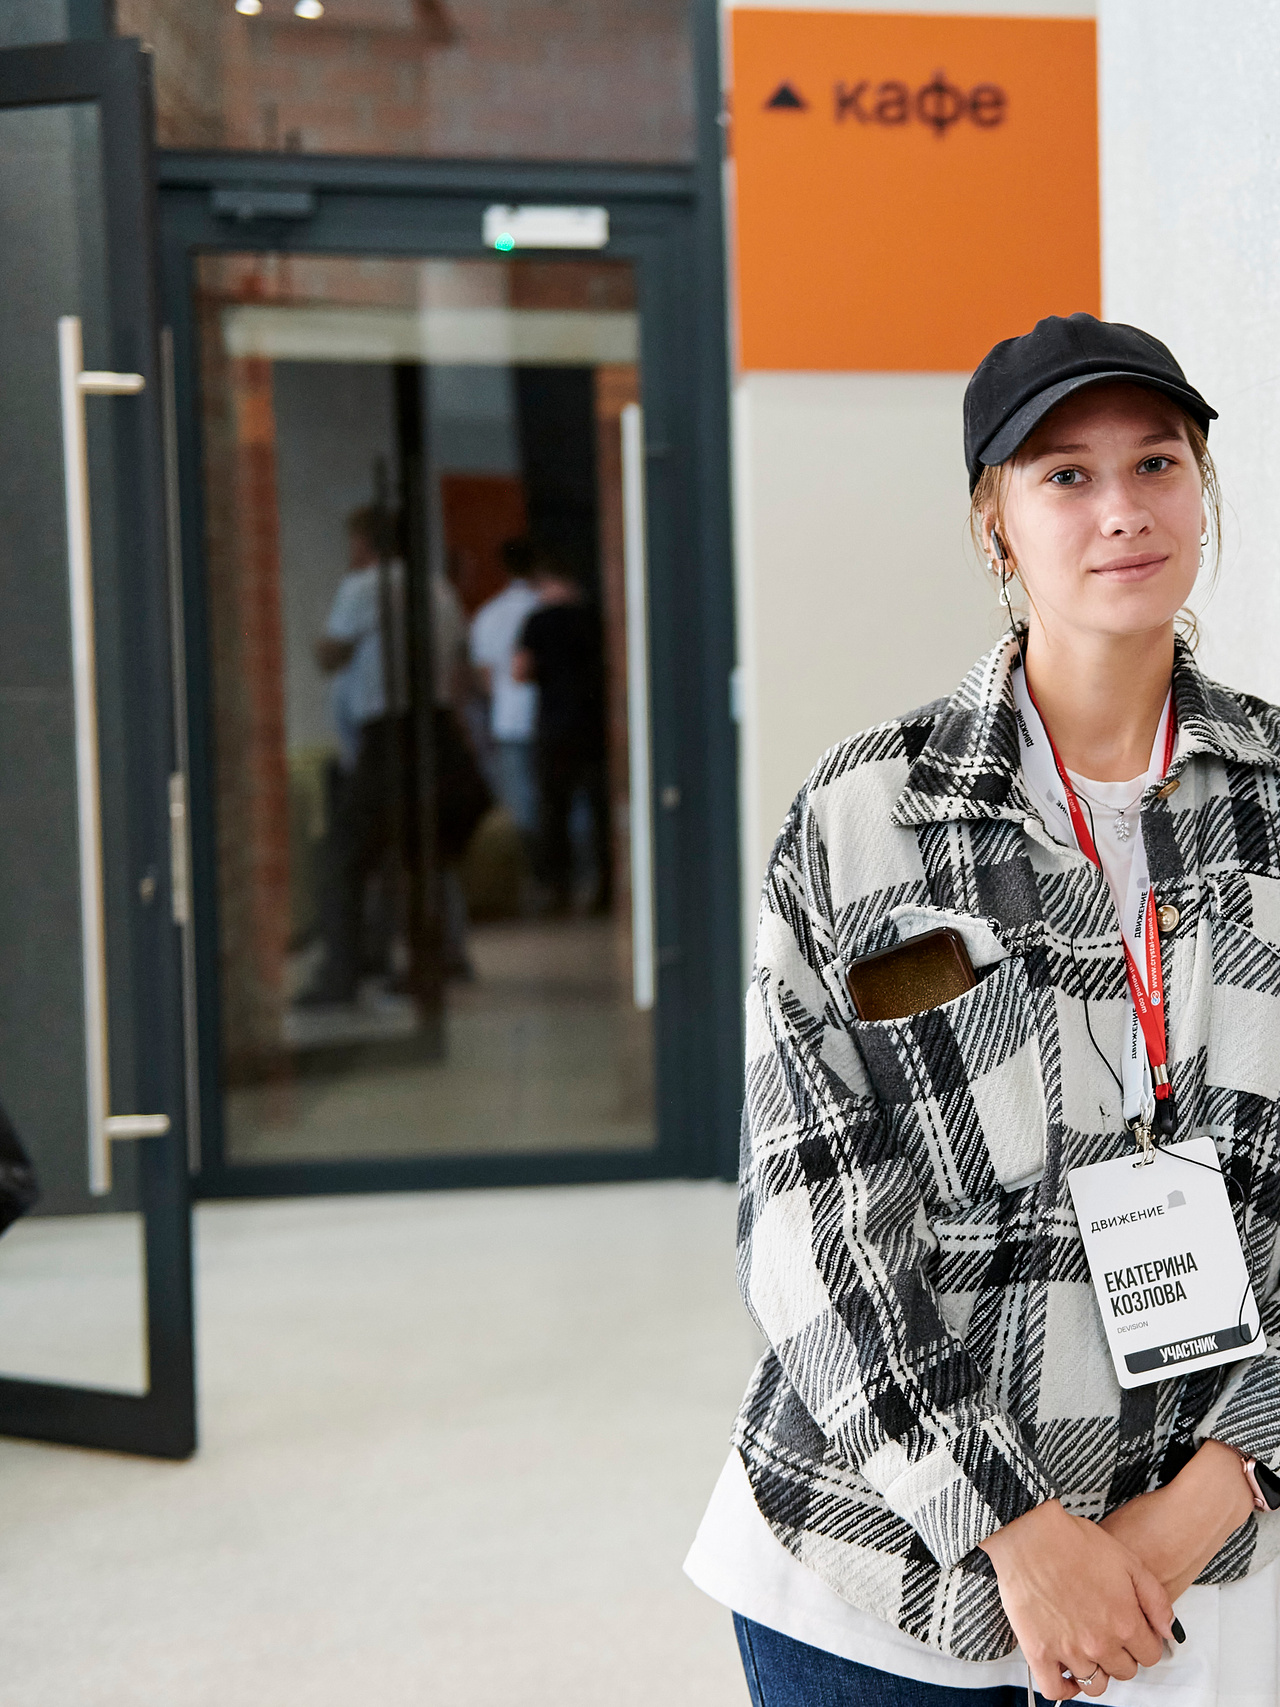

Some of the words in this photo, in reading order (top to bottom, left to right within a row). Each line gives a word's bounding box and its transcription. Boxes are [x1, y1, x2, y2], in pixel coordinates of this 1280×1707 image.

[833, 68, 1008, 139] кафе
[1134, 891, 1149, 938] ДВИЖЕНИЕ
[1090, 1205, 1165, 1233] ДВИЖЕНИЕ
[1104, 1252, 1198, 1293] ЕКАТЕРИНА
[1110, 1280, 1187, 1317] КОЗЛОВА
[1117, 1321, 1149, 1334] DEVISION
[1160, 1335, 1218, 1363] УЧАСТНИК
